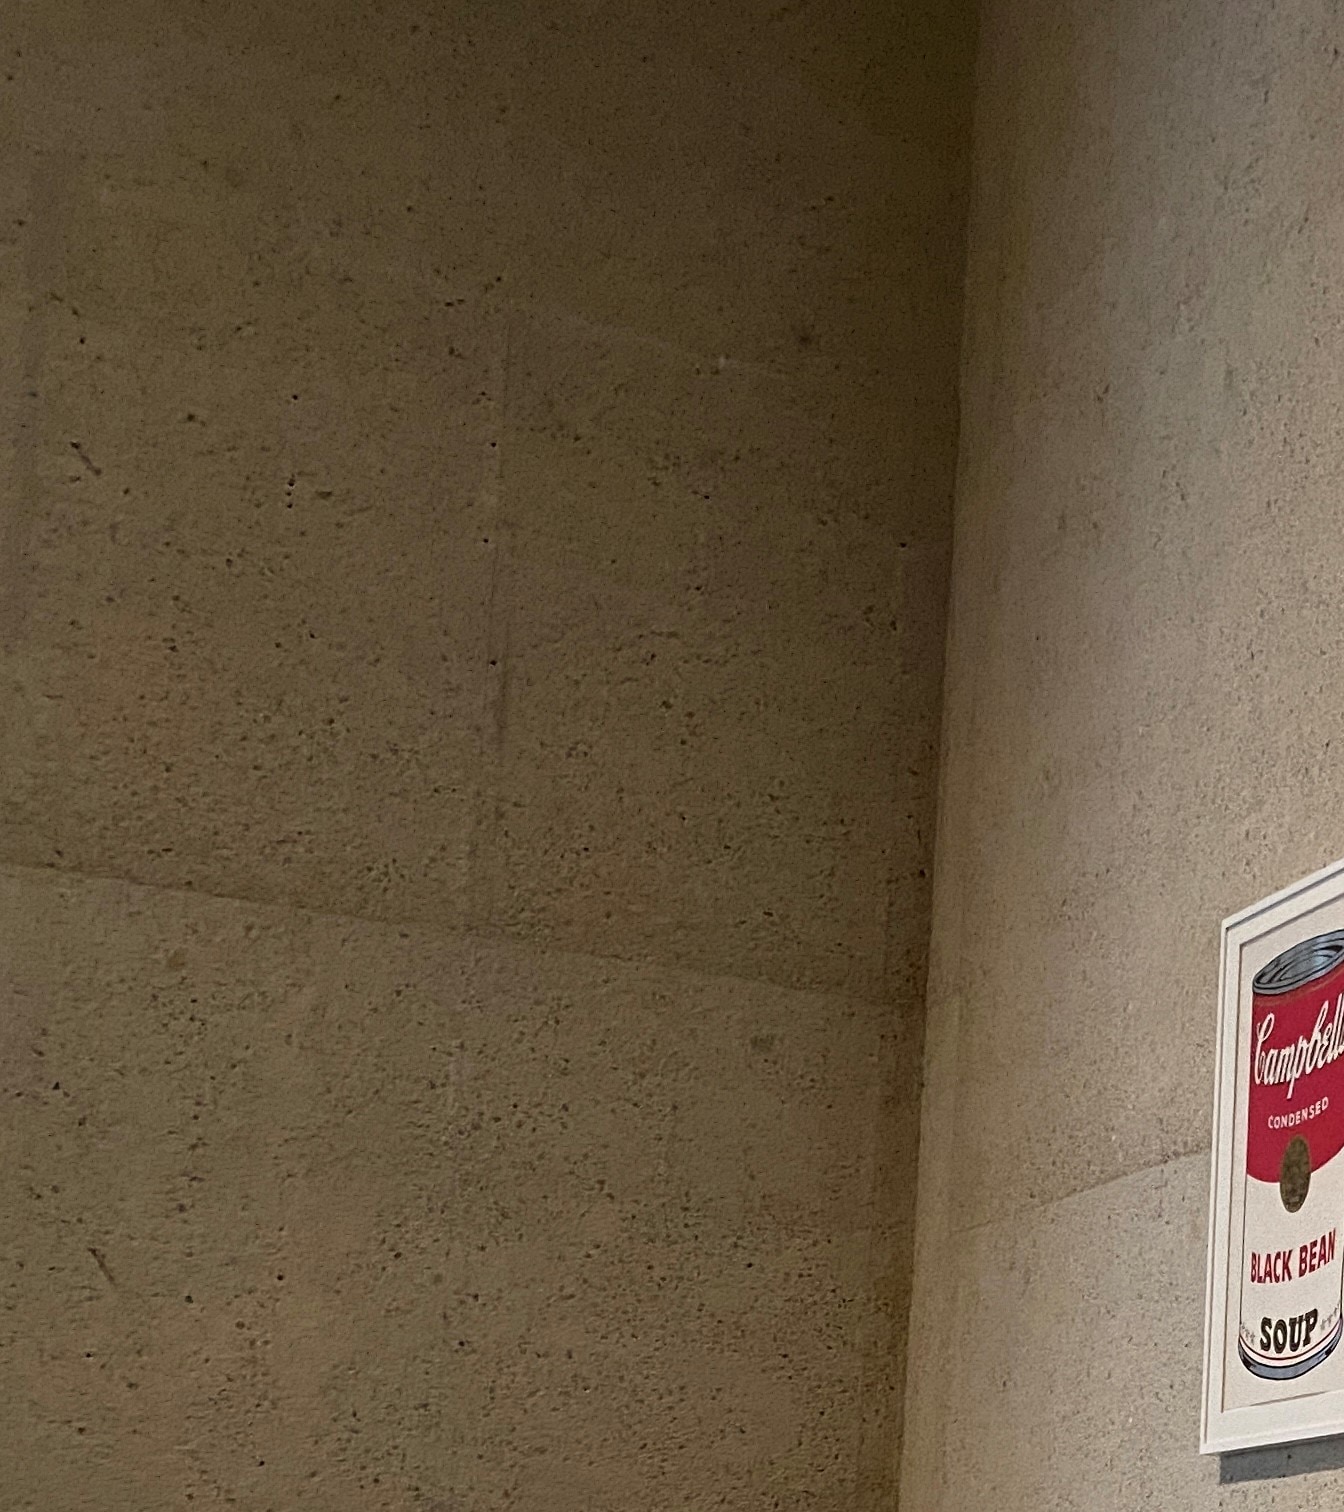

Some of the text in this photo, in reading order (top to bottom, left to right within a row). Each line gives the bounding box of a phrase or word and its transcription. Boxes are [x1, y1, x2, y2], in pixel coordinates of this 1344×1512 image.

[1267, 1096, 1329, 1130] CONDENSED
[1250, 1226, 1336, 1284] BLACK BEAN
[1259, 1307, 1319, 1354] SOUP
